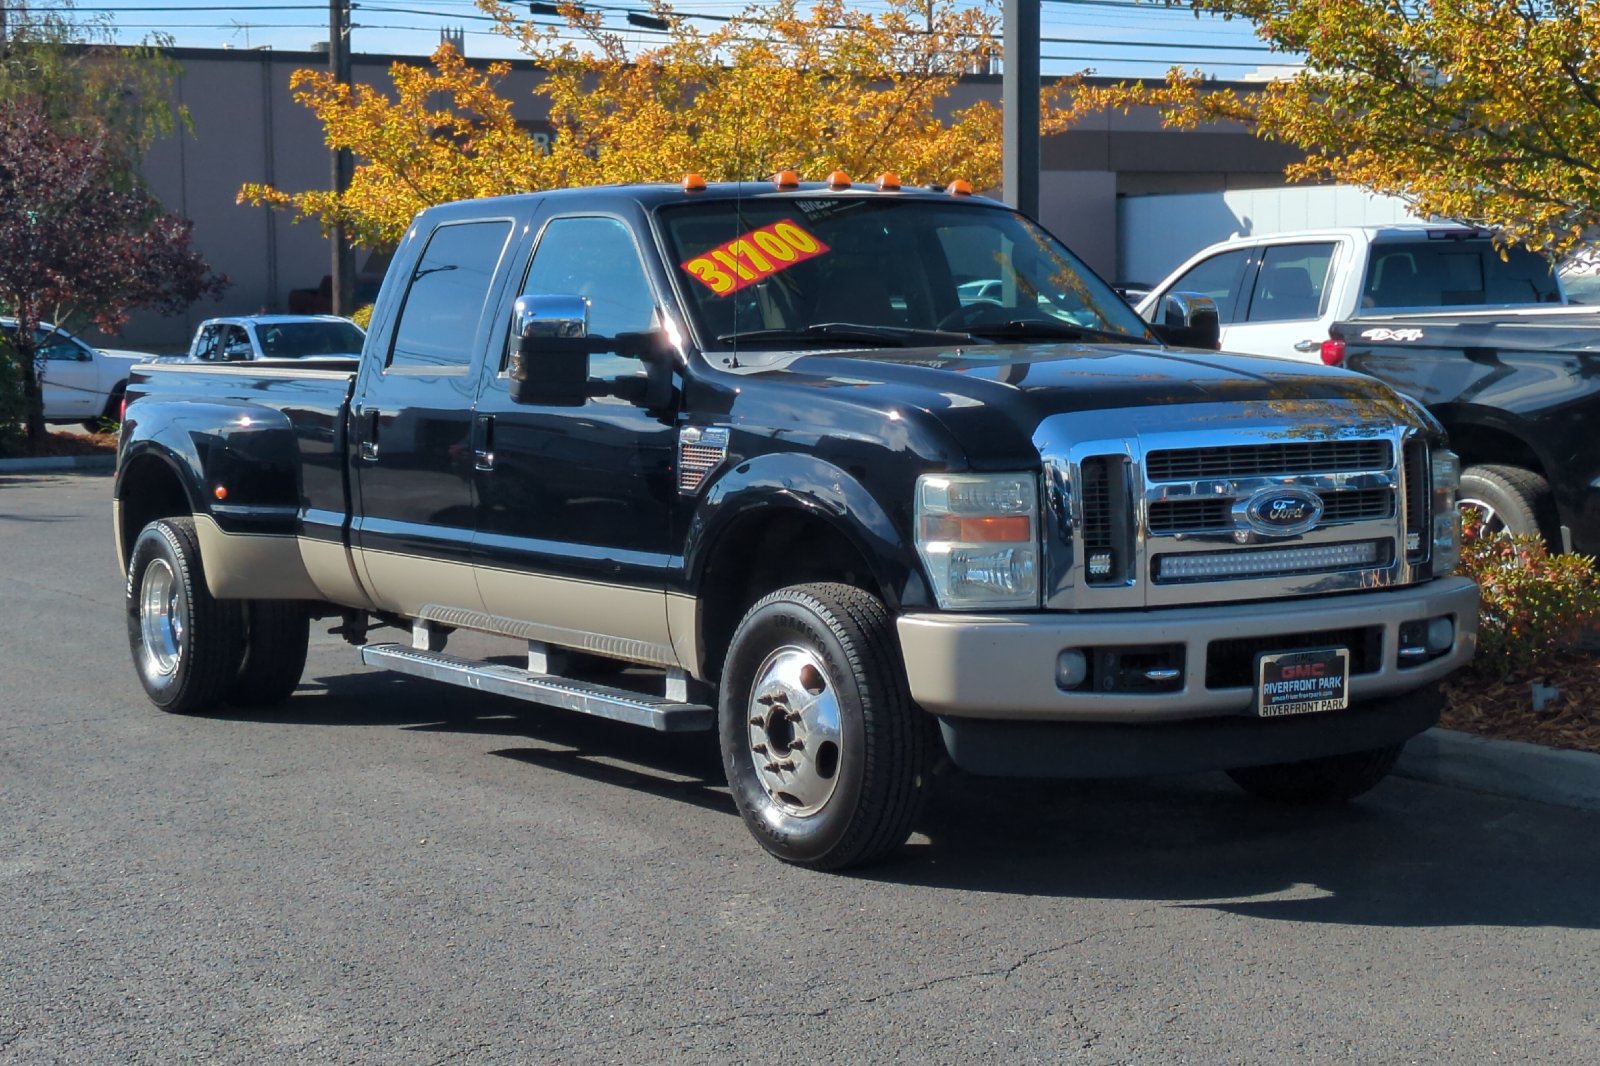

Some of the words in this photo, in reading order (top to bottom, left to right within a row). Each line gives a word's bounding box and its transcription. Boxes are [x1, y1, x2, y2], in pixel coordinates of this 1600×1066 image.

[687, 222, 820, 293] 31700
[1269, 500, 1305, 520] Ford
[1281, 663, 1325, 679] GMC
[1263, 680, 1317, 695] RIVERFRONT
[1318, 676, 1342, 690] PARK
[1262, 701, 1319, 716] RIVERFRONT
[1321, 699, 1344, 711] PARK
